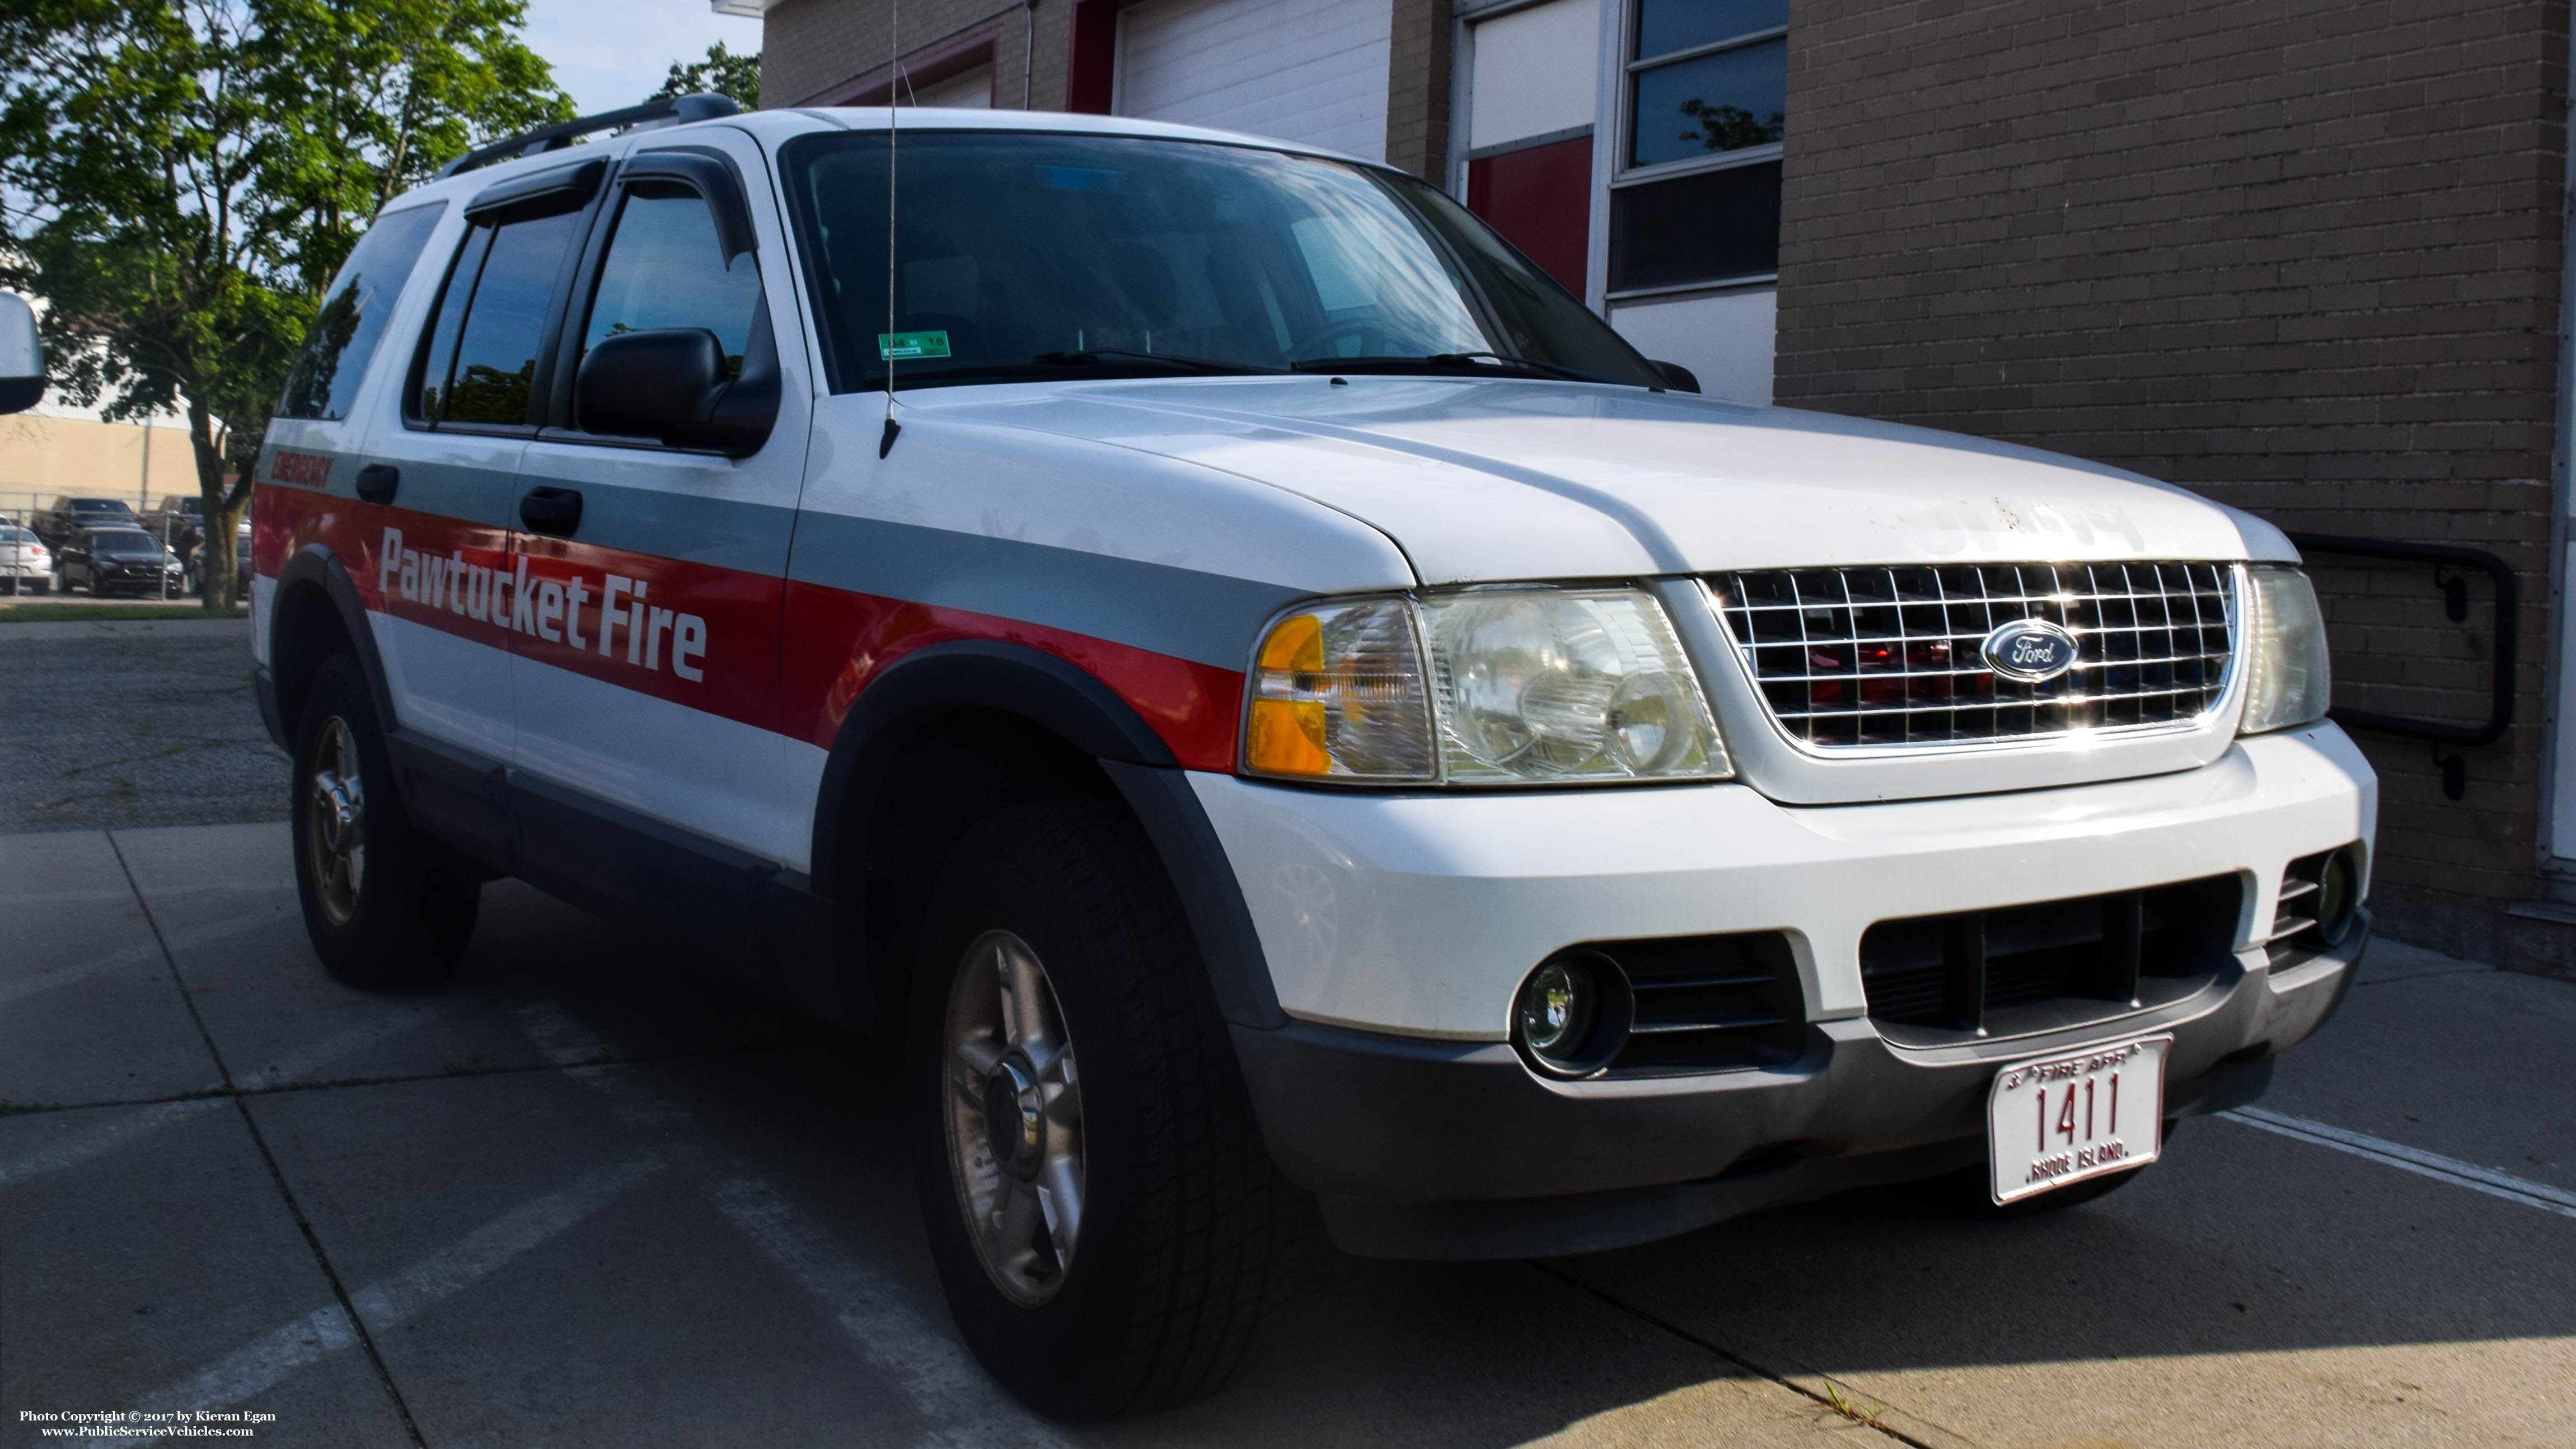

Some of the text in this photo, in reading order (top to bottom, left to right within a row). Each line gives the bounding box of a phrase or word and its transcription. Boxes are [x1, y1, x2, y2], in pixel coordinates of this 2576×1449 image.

[928, 337, 944, 345] 18
[379, 526, 707, 683] Pawtucket Fire
[2012, 636, 2054, 663] Ford
[2036, 1059, 2084, 1082] FIRE
[2037, 1070, 2119, 1152] 1411
[2031, 1138, 2123, 1181] RHODE ISLAND
